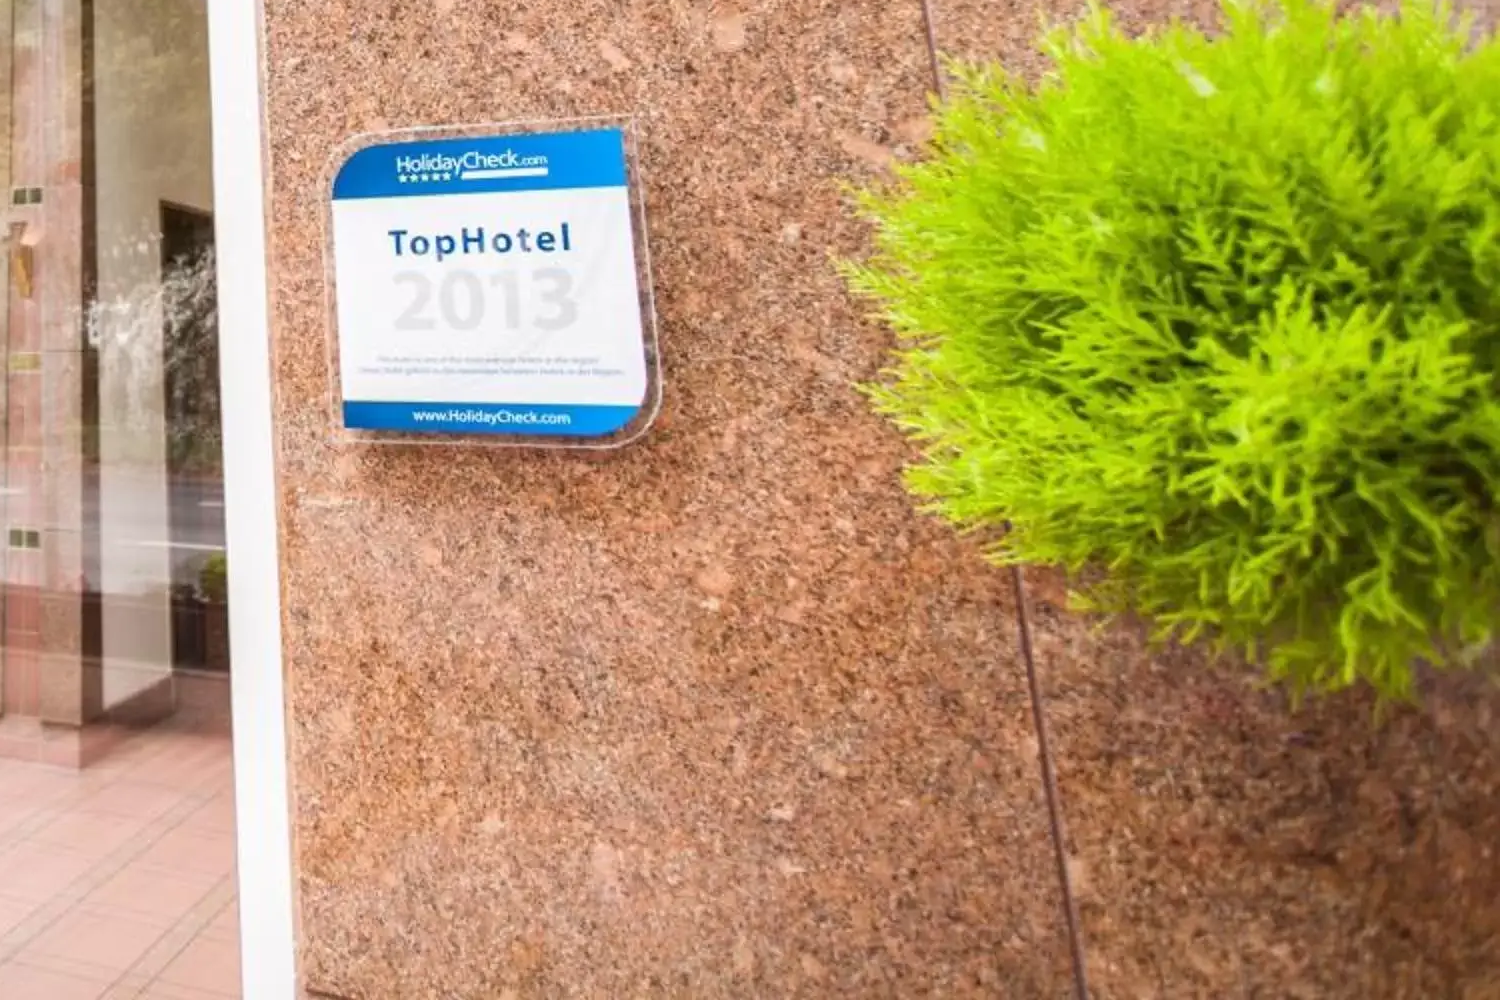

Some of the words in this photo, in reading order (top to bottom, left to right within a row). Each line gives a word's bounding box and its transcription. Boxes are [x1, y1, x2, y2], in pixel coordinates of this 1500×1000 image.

[395, 148, 549, 176] HolidayCheck.com
[388, 221, 571, 262] TopHotel
[392, 267, 579, 332] 2013
[412, 408, 572, 426] www.HolidayCheck.com
